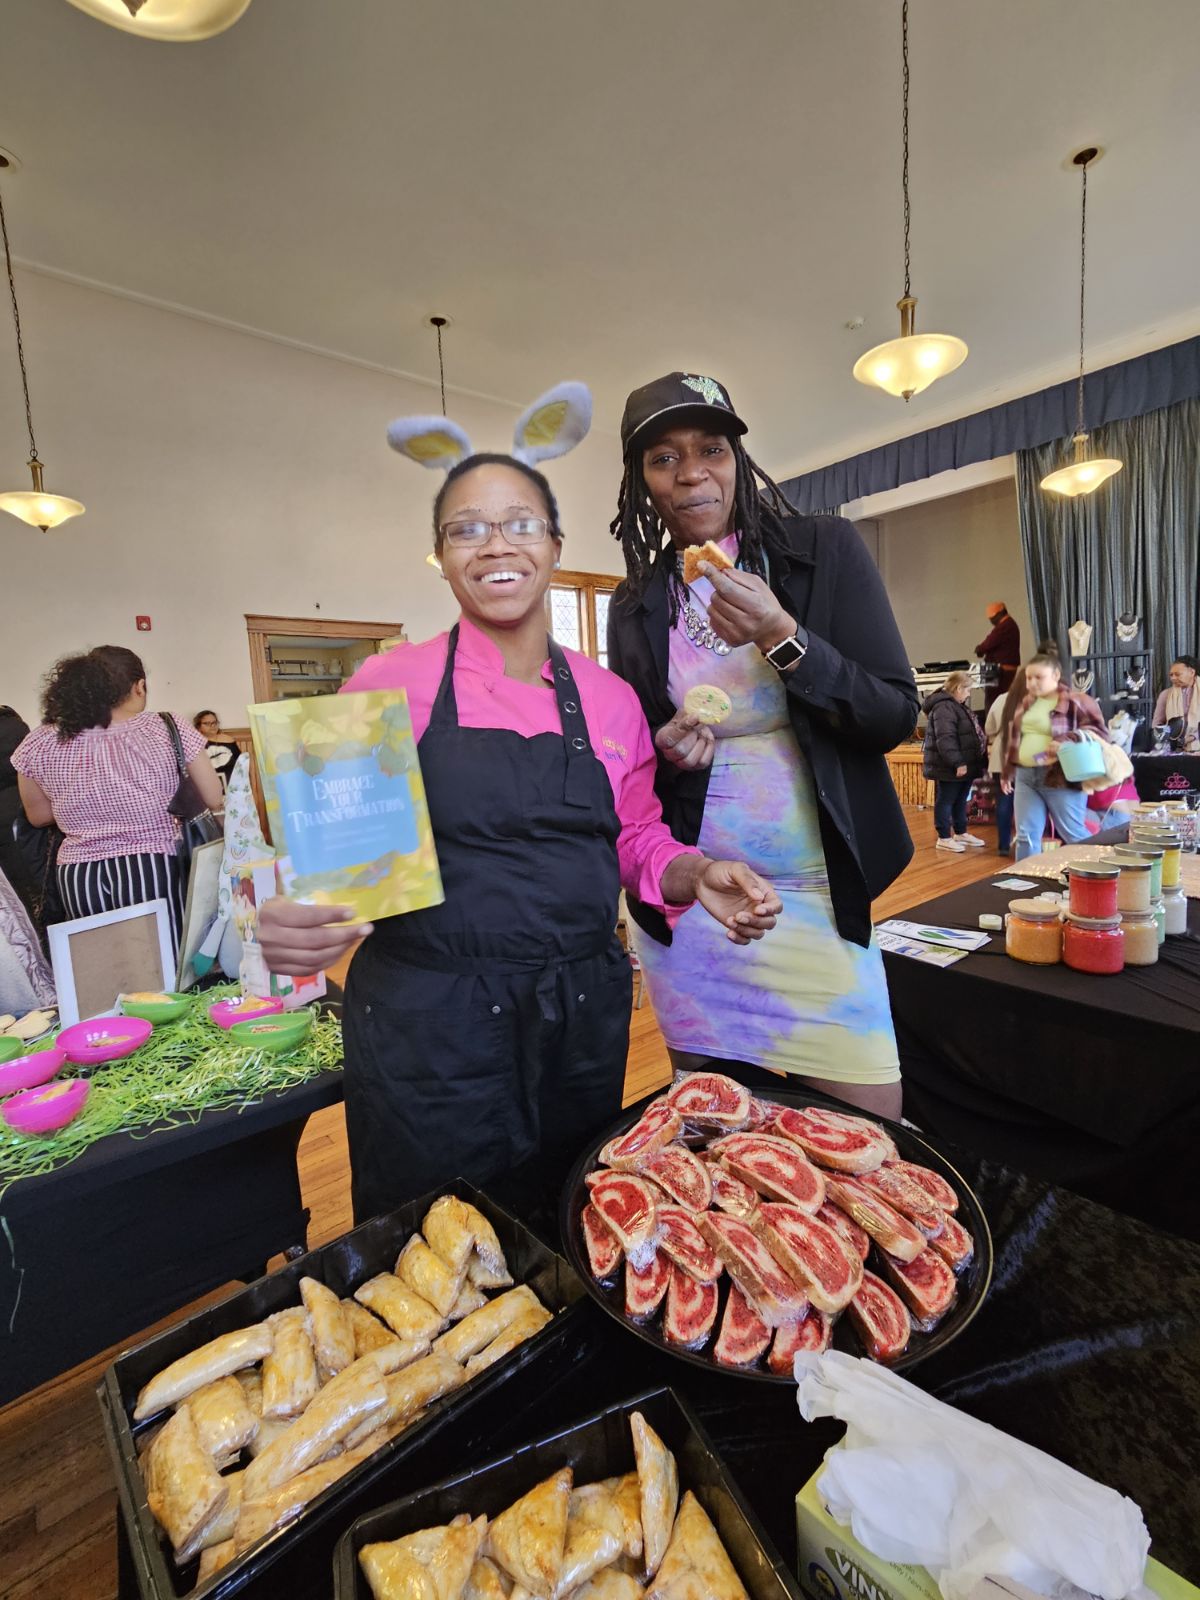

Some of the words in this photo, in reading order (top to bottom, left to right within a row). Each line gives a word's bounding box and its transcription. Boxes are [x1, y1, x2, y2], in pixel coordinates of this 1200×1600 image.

[312, 775, 375, 800] EMBRACE
[330, 791, 363, 808] YOUR
[287, 798, 405, 832] TRANSFORMATION
